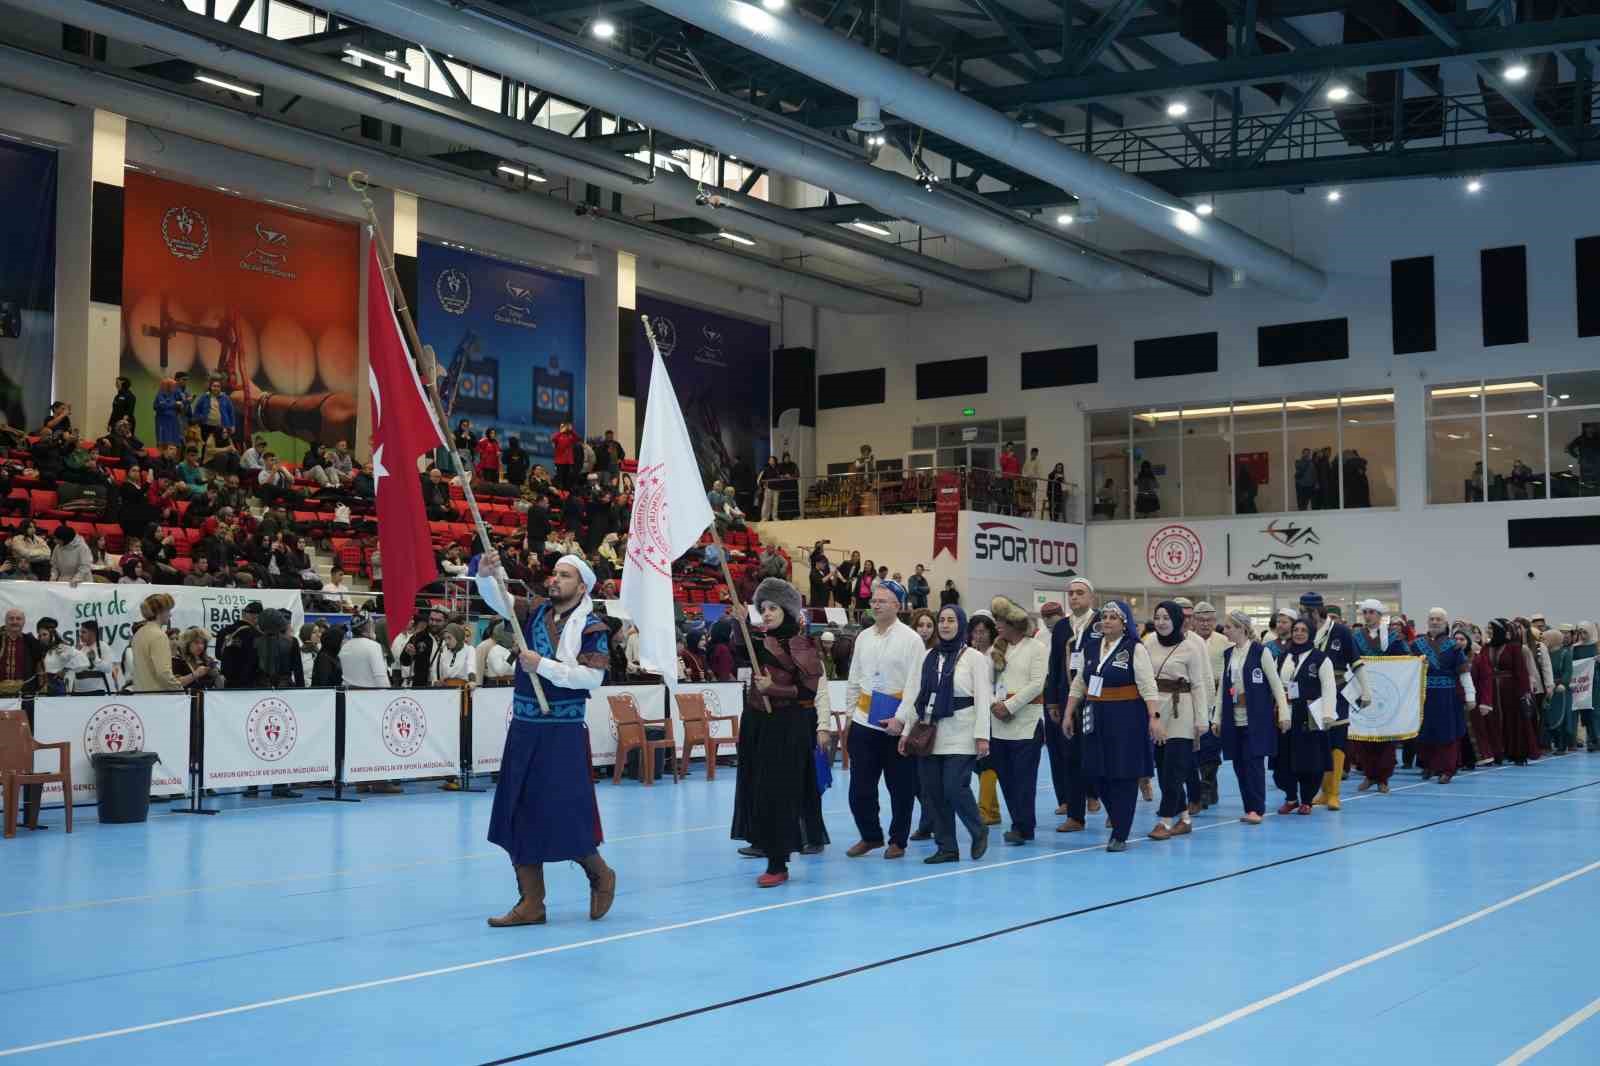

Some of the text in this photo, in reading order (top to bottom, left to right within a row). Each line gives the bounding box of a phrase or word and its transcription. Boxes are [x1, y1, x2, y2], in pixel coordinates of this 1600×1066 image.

[1274, 561, 1301, 573] Türkiye
[75, 590, 127, 619] sen de
